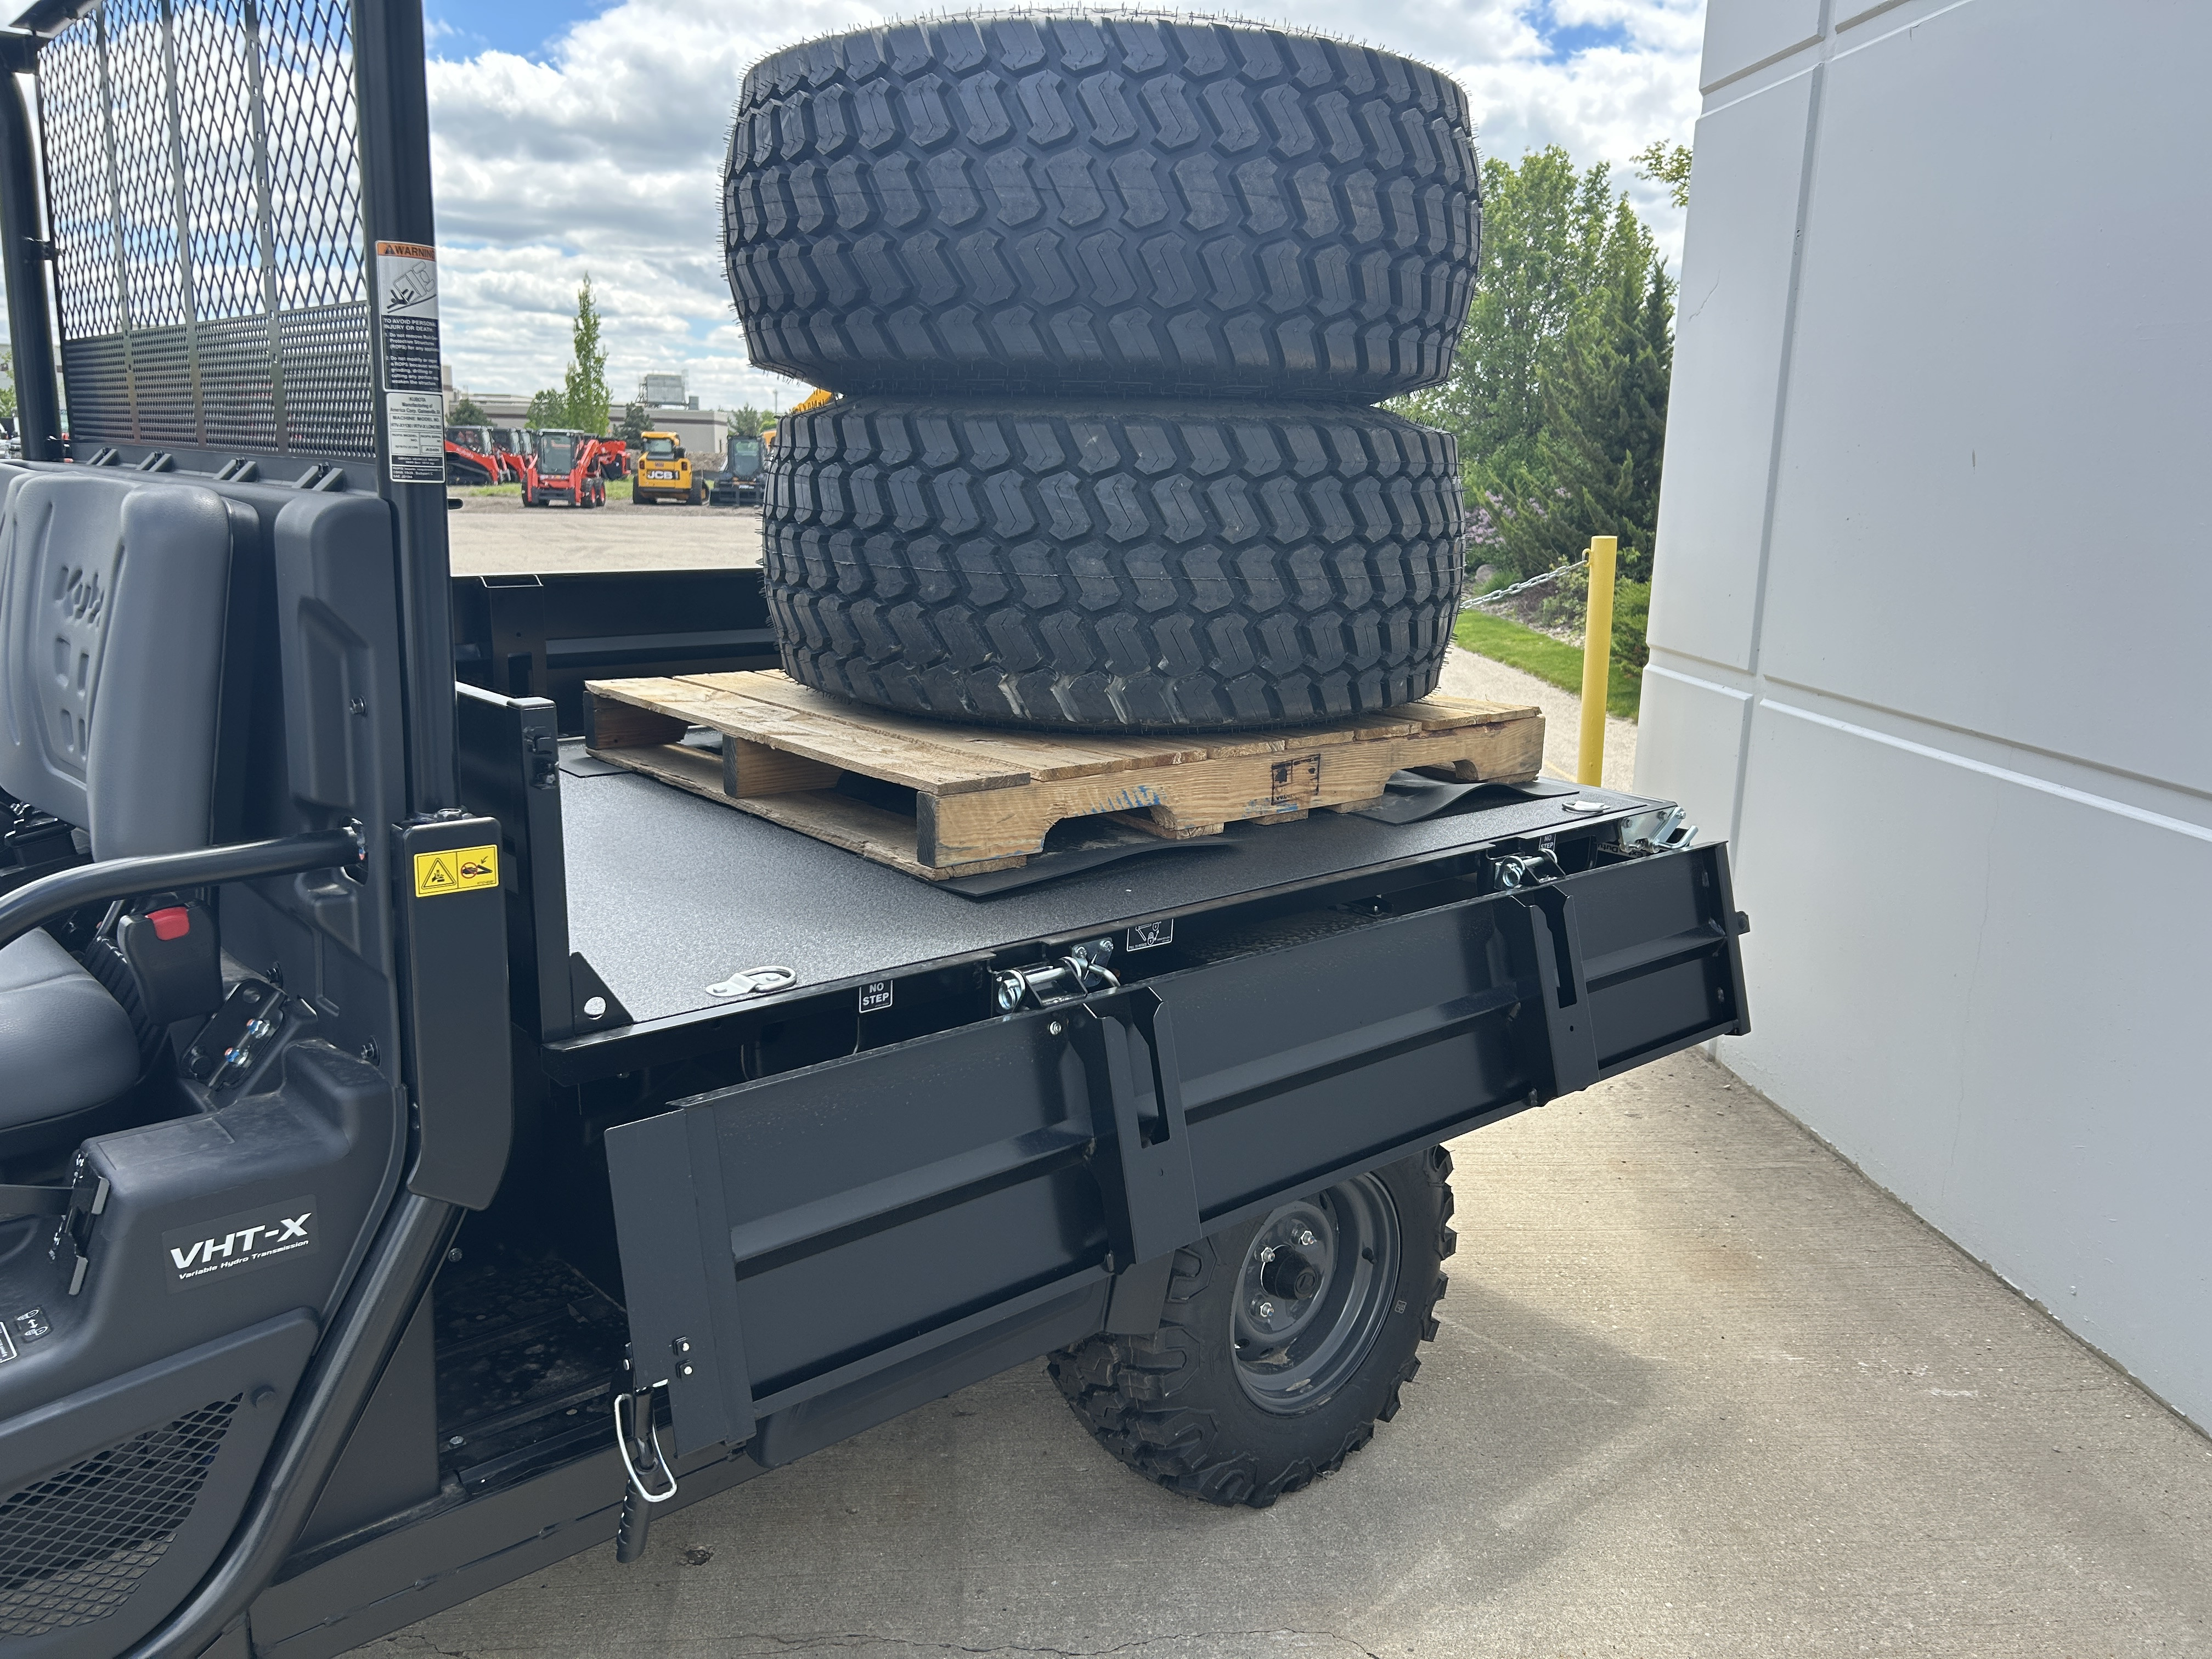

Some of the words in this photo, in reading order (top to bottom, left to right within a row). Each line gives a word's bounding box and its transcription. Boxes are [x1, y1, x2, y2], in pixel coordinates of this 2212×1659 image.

[394, 245, 435, 259] WARNING
[647, 471, 673, 480] JCB
[1544, 834, 1552, 842] NO
[869, 982, 884, 994] NO
[862, 992, 889, 1006] STEP
[170, 1212, 312, 1269] VHT-X
[179, 1265, 218, 1279] Variable
[221, 1257, 249, 1268] Hydro
[251, 1240, 309, 1260] Transmission
